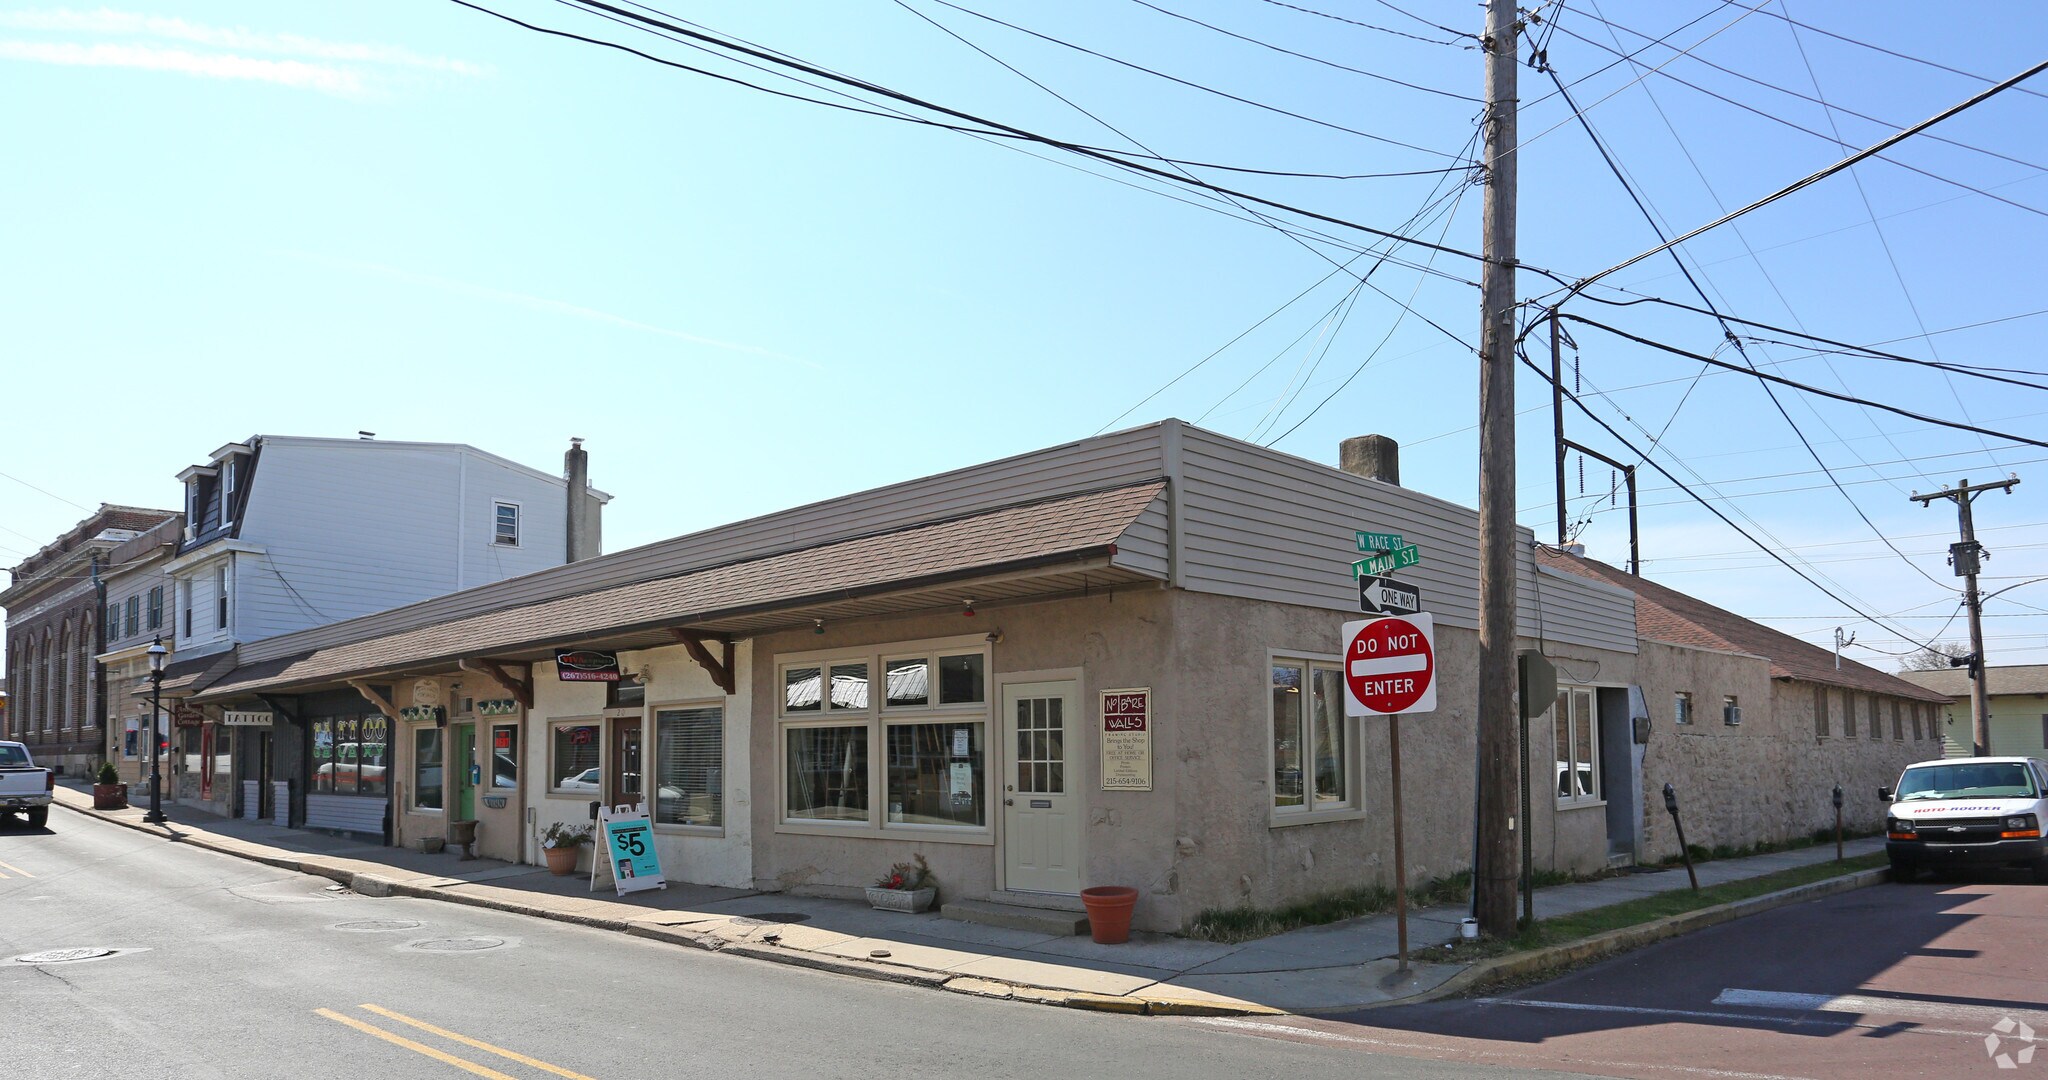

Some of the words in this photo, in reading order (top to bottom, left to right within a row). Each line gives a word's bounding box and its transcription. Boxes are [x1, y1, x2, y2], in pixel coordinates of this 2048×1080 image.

[1357, 534, 1365, 548] W
[1368, 535, 1390, 550] RACE
[1392, 537, 1402, 550] ST
[1356, 563, 1364, 575] N
[1369, 554, 1396, 574] MAIN
[1401, 548, 1414, 565] ST
[1381, 588, 1398, 605] ONE
[1399, 592, 1415, 609] WAY
[1357, 638, 1378, 654] DO
[1387, 633, 1418, 651] NOT
[562, 672, 618, 680] (267)516-4240
[1364, 678, 1415, 696] ENTER
[227, 714, 271, 723] TATTOO
[1109, 717, 1142, 728] WALLS
[1913, 806, 2001, 814] ROTO-ROOTER
[617, 833, 645, 856] $5
